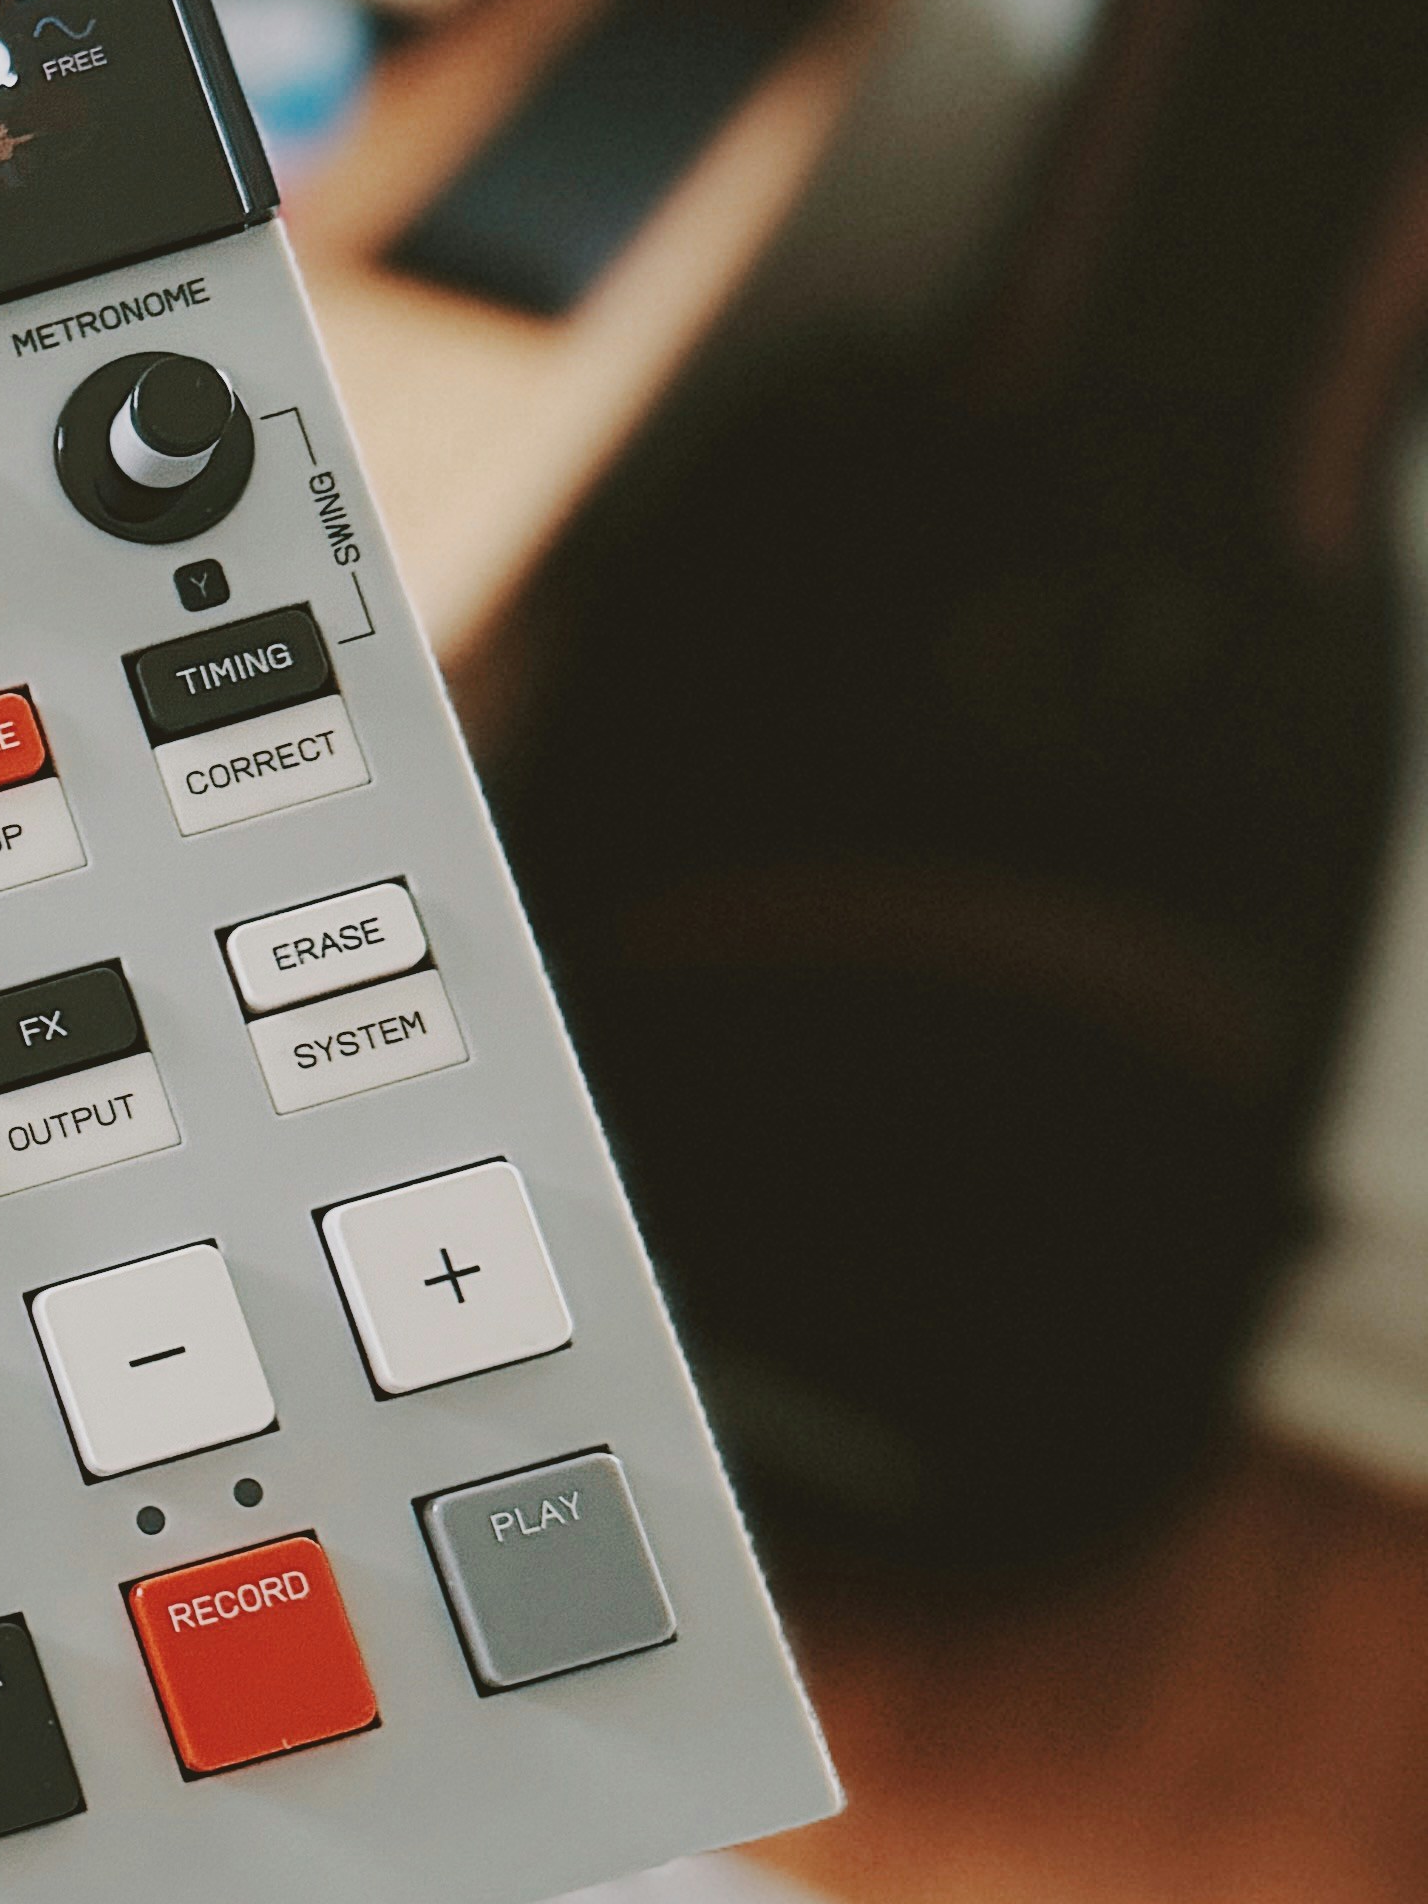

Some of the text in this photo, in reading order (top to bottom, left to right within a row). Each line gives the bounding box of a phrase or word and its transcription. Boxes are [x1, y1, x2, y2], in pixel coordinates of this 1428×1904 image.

[42, 45, 108, 83] FREE
[10, 277, 211, 358] METRONOME
[308, 470, 362, 567] SWING
[176, 642, 294, 696] TIMING
[184, 730, 337, 796] CORRECT
[270, 915, 386, 973] ERASE
[19, 1009, 69, 1047] FX
[292, 1010, 428, 1073] SYSTEM
[7, 1093, 136, 1153] OUTPUT
[488, 1490, 585, 1545] PLAY
[166, 1569, 311, 1634] RECORD
